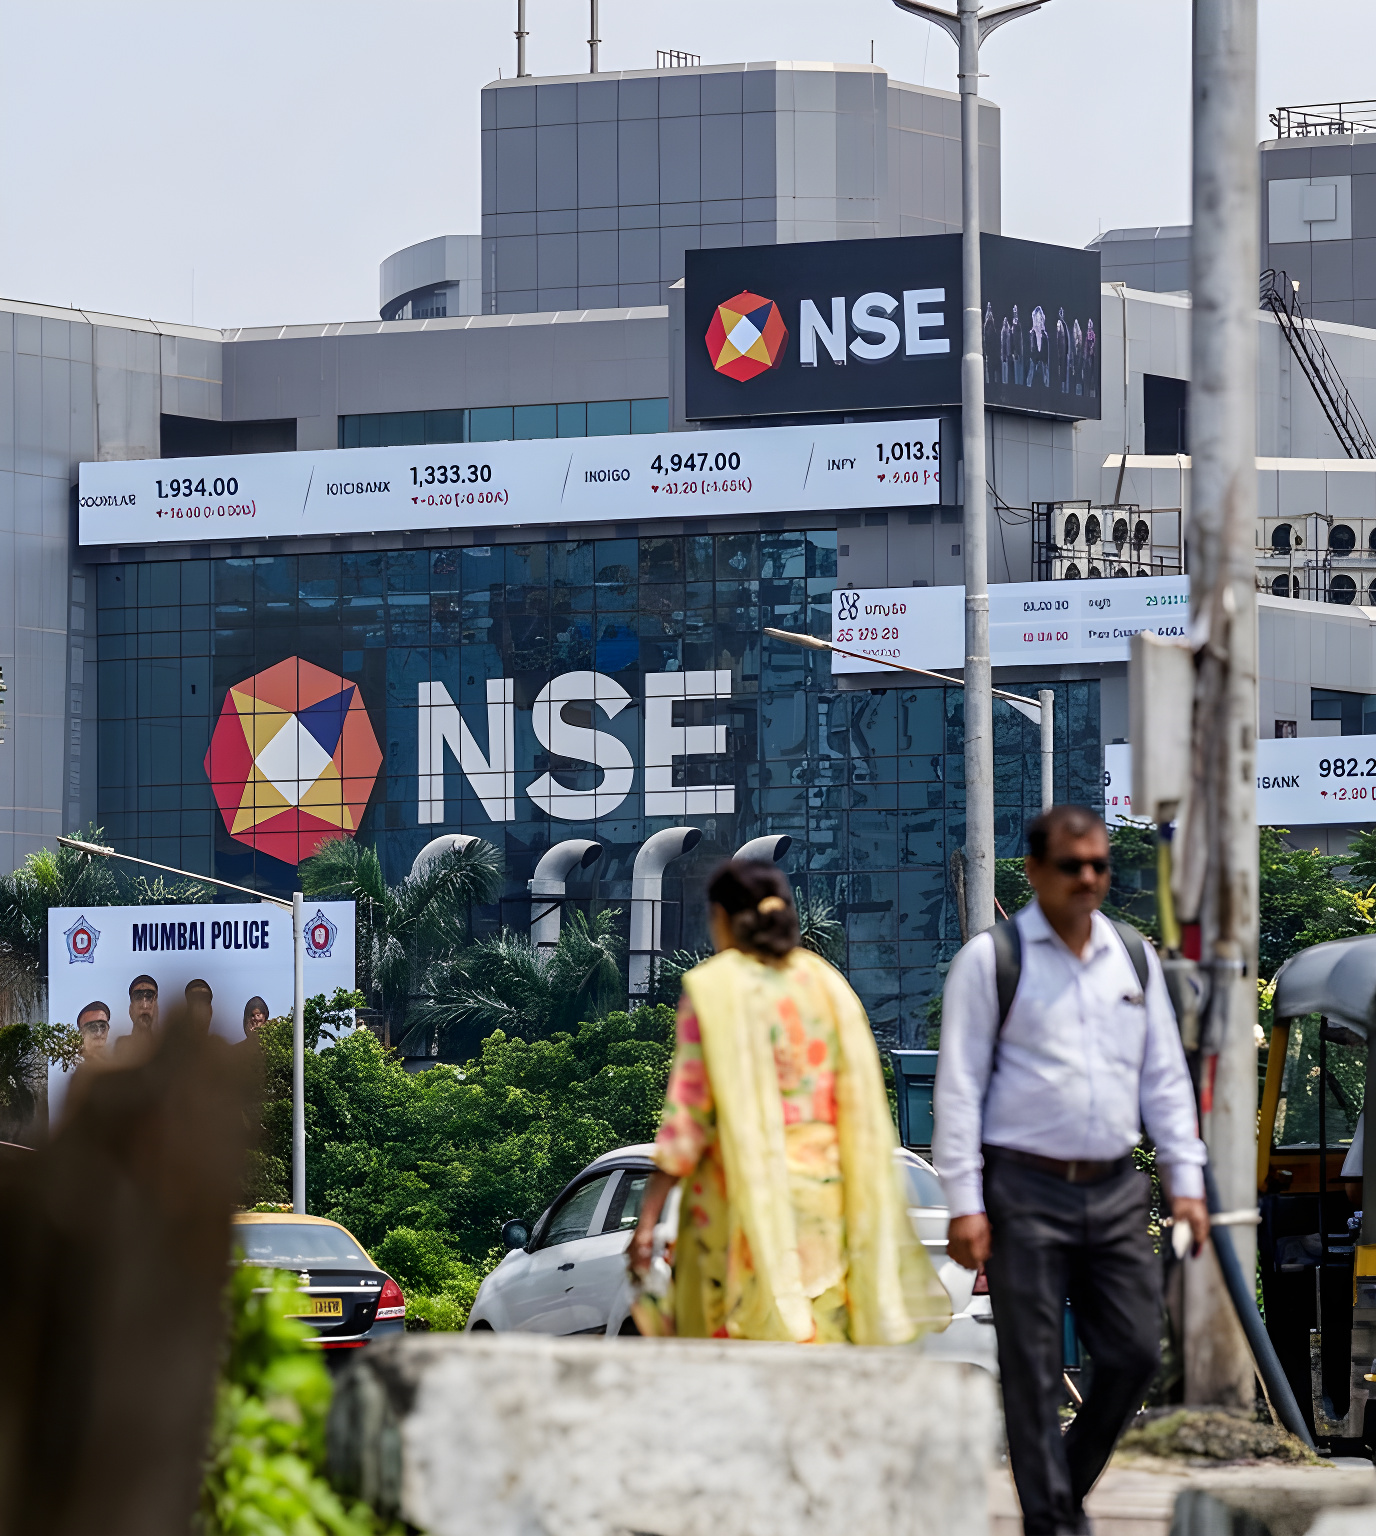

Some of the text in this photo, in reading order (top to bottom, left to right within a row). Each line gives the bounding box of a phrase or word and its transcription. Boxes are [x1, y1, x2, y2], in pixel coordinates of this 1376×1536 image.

[799, 288, 951, 367] NSE
[410, 465, 492, 487] 1,333.30
[584, 452, 741, 482] INDIGO 4,947.00
[417, 669, 736, 824] NSE
[132, 919, 270, 952] MUMBAI POLICE
